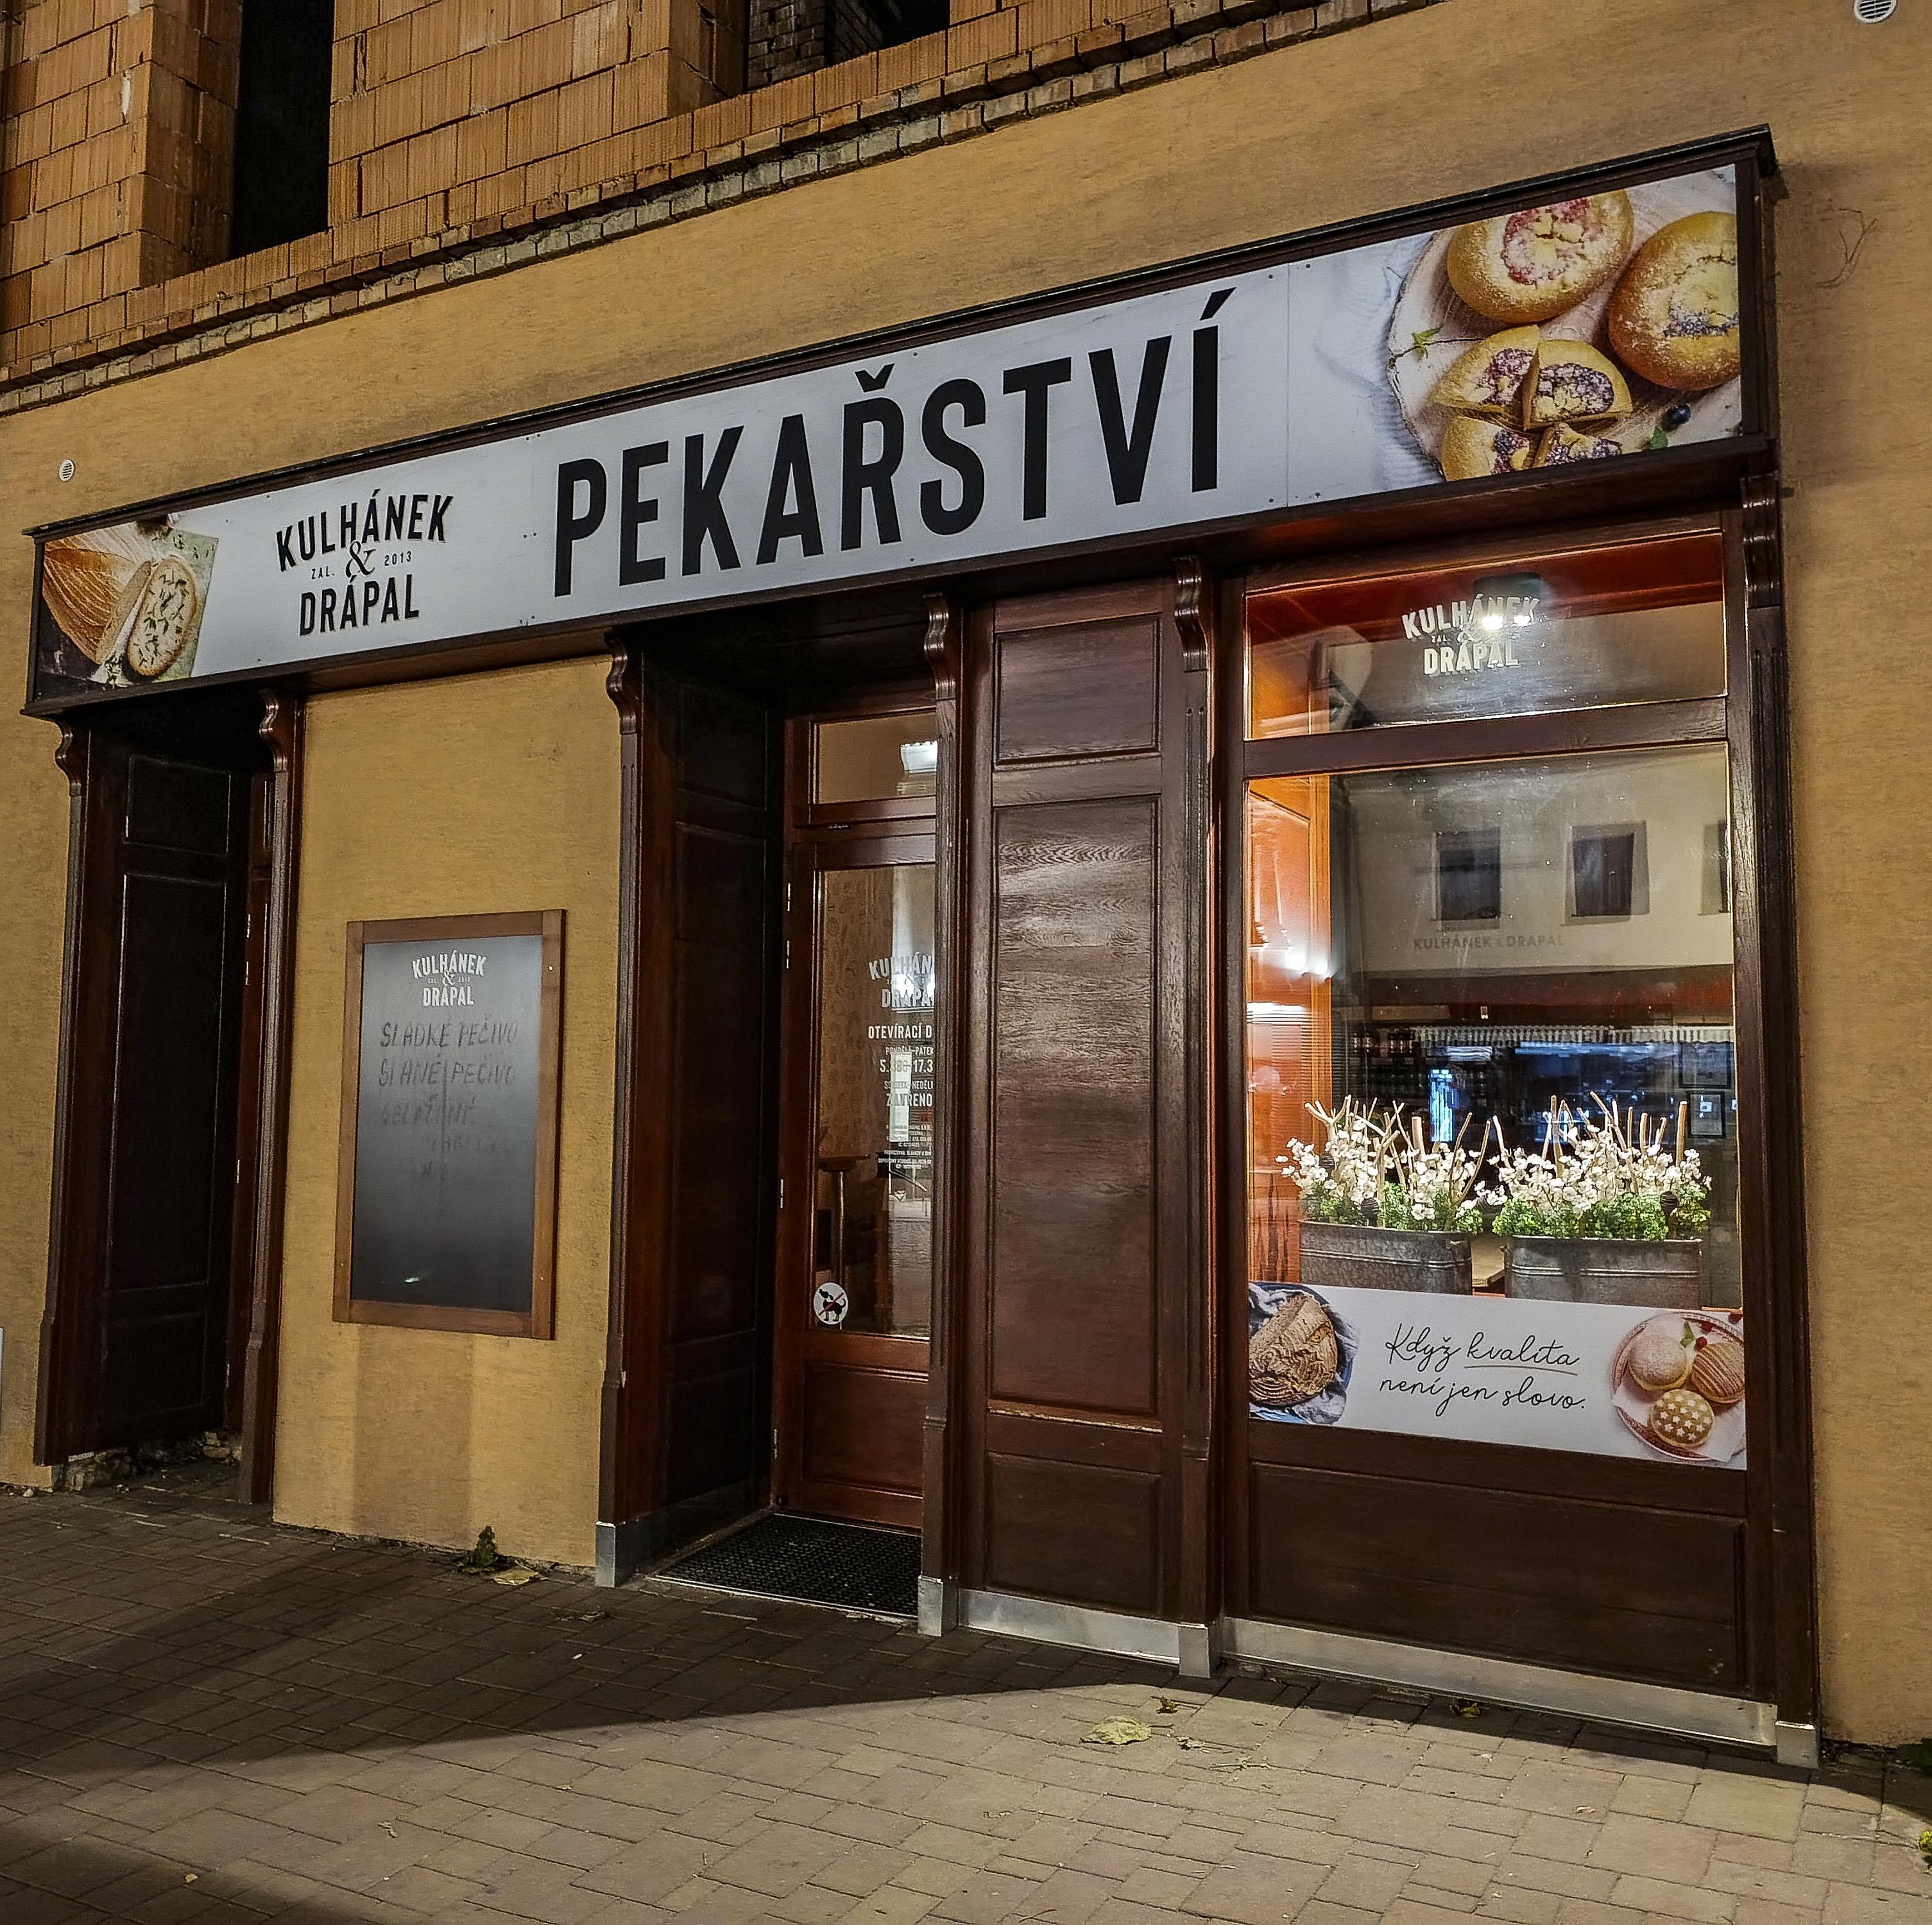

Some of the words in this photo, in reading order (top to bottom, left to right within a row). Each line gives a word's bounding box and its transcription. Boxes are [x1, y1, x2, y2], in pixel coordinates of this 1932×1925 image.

[554, 286, 1236, 597] PEKAŘSTVÍ
[276, 488, 454, 572] KULHÁNEK
[311, 566, 335, 579] ZAL.
[345, 541, 376, 578] &
[384, 551, 412, 566] 2013
[299, 574, 420, 636] DRÁPAL
[412, 949, 487, 979] KULHÁNEK
[422, 986, 475, 1007] DRÁPAL
[868, 1023, 923, 1039] OTEVÍRACÍ
[1385, 1322, 1462, 1373] Když
[1467, 1331, 1580, 1366] kvalita
[1380, 1377, 1445, 1395] není
[1435, 1382, 1499, 1417] jen
[1501, 1376, 1586, 1409] slovo.
